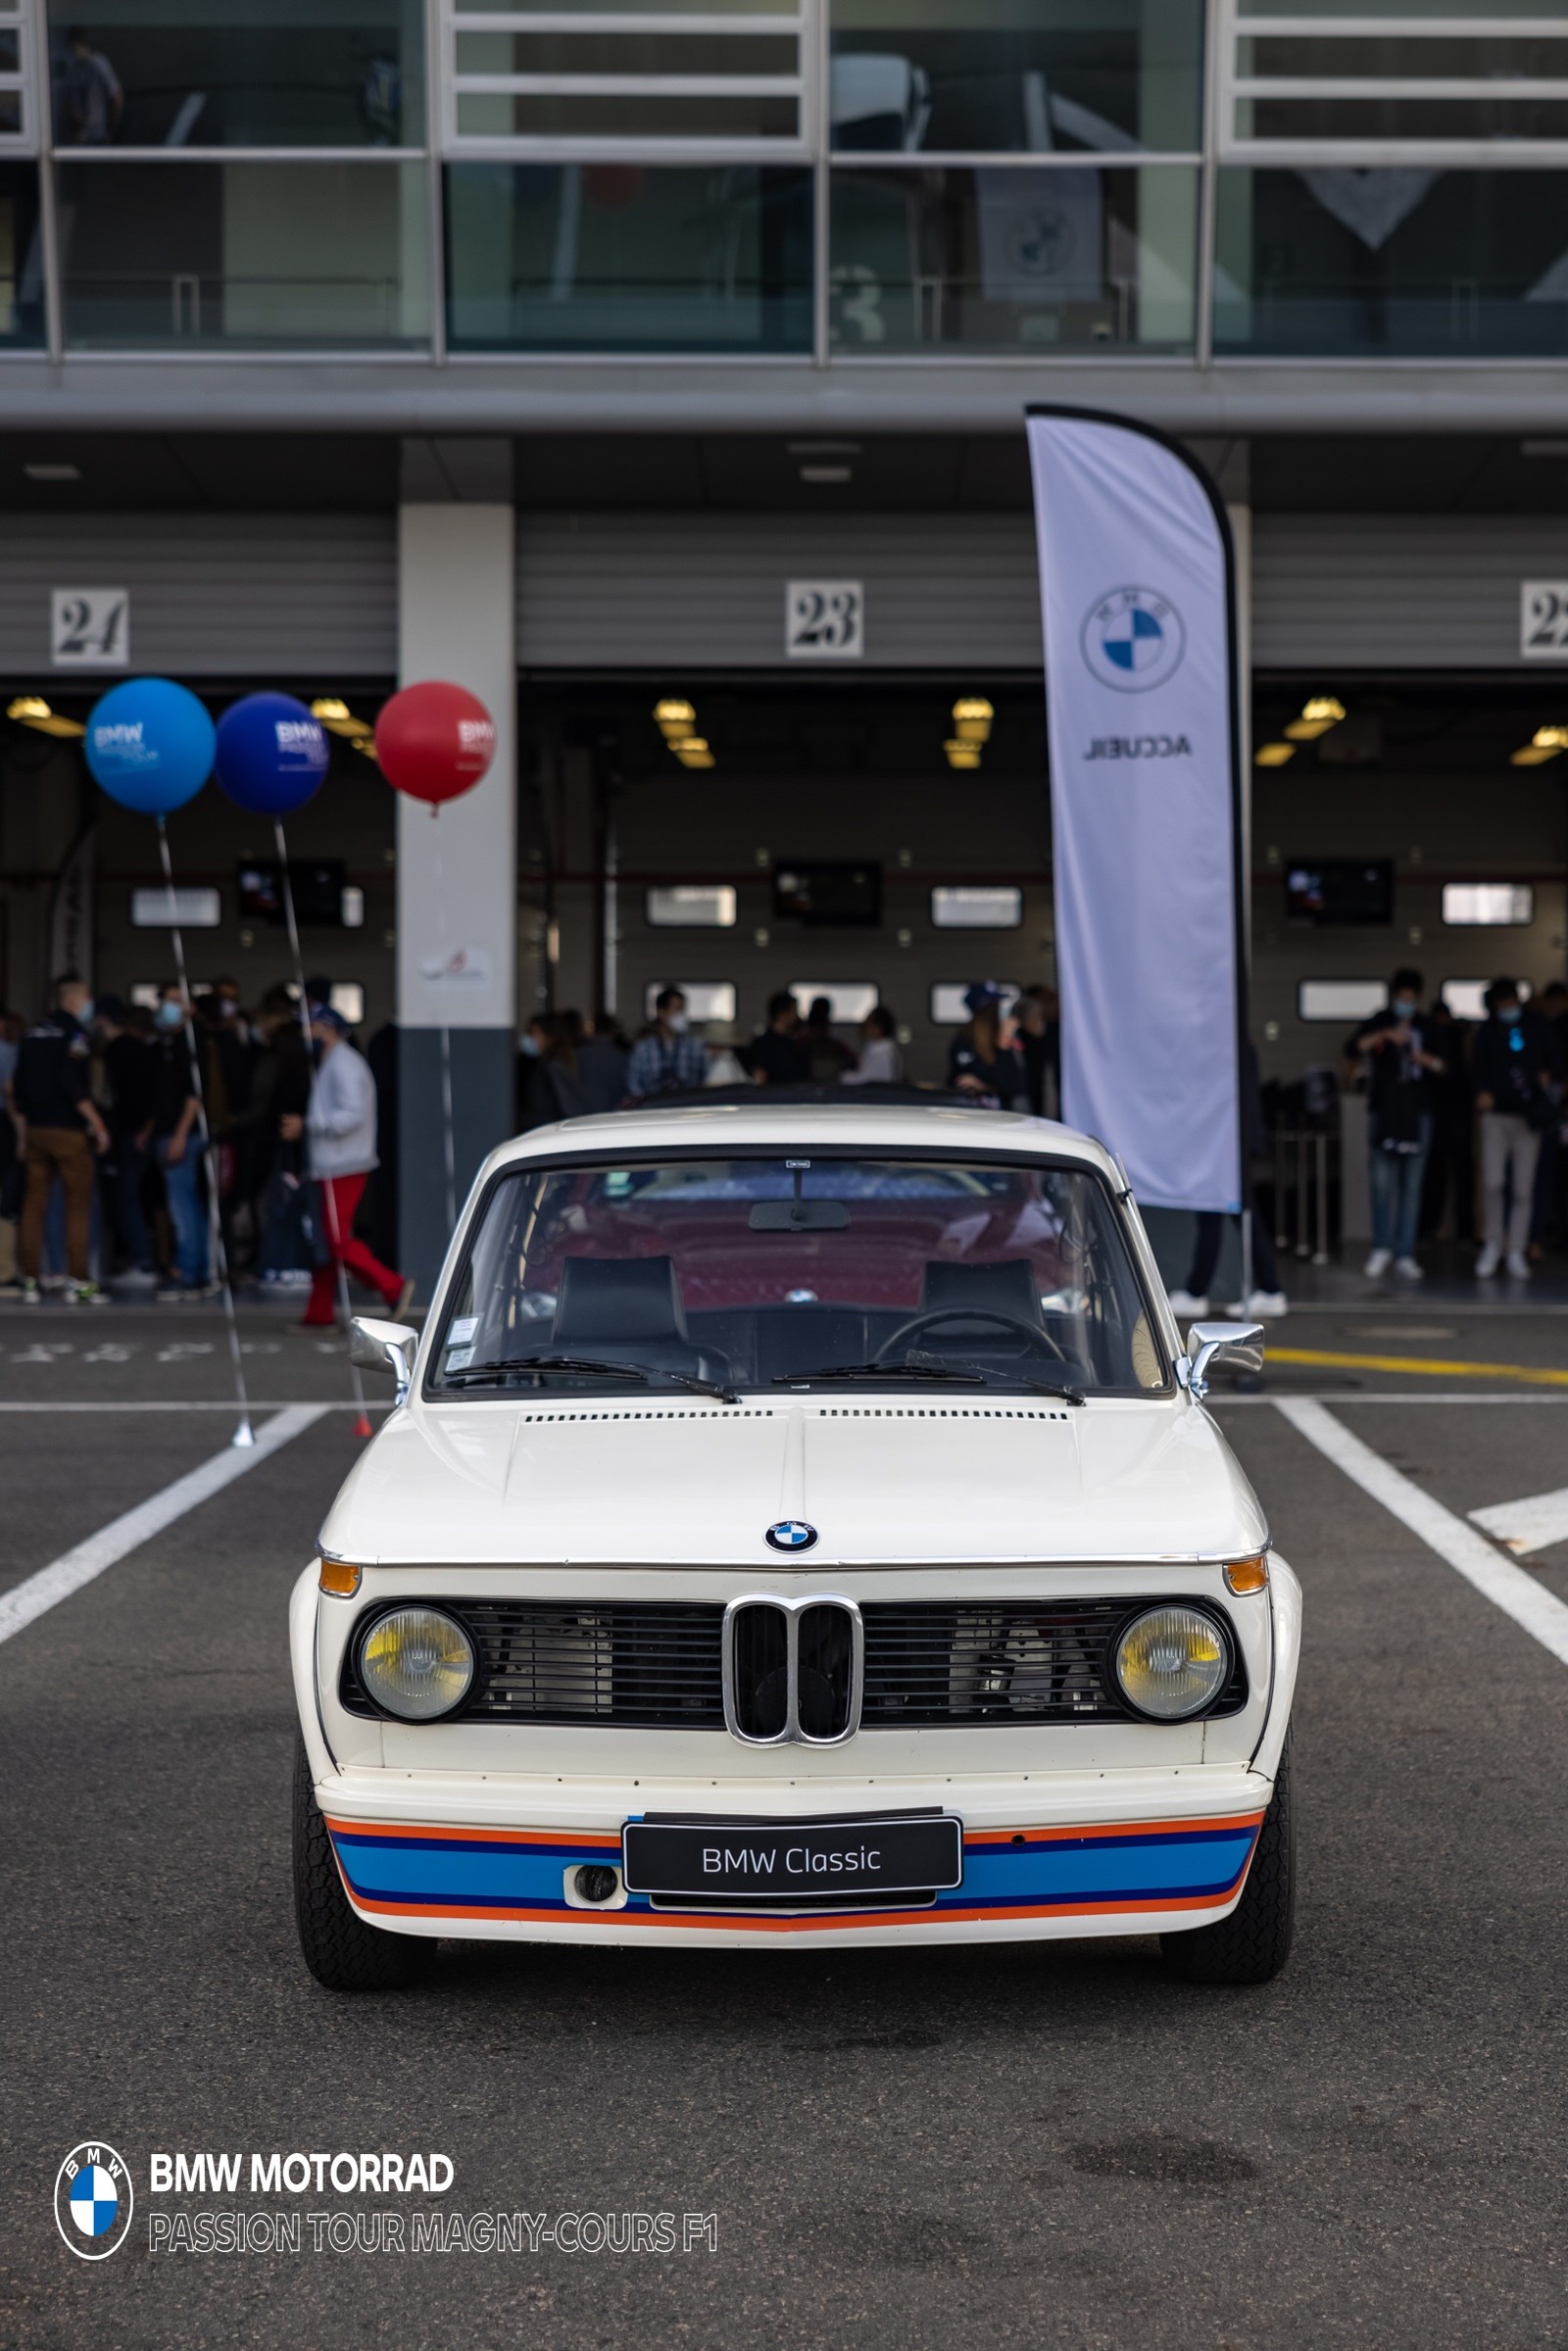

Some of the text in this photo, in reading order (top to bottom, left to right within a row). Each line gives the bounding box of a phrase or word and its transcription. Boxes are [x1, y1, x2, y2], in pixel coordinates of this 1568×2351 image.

[793, 590, 858, 648] 23
[94, 721, 143, 748] BMW
[703, 1845, 881, 1873] BMW Classic
